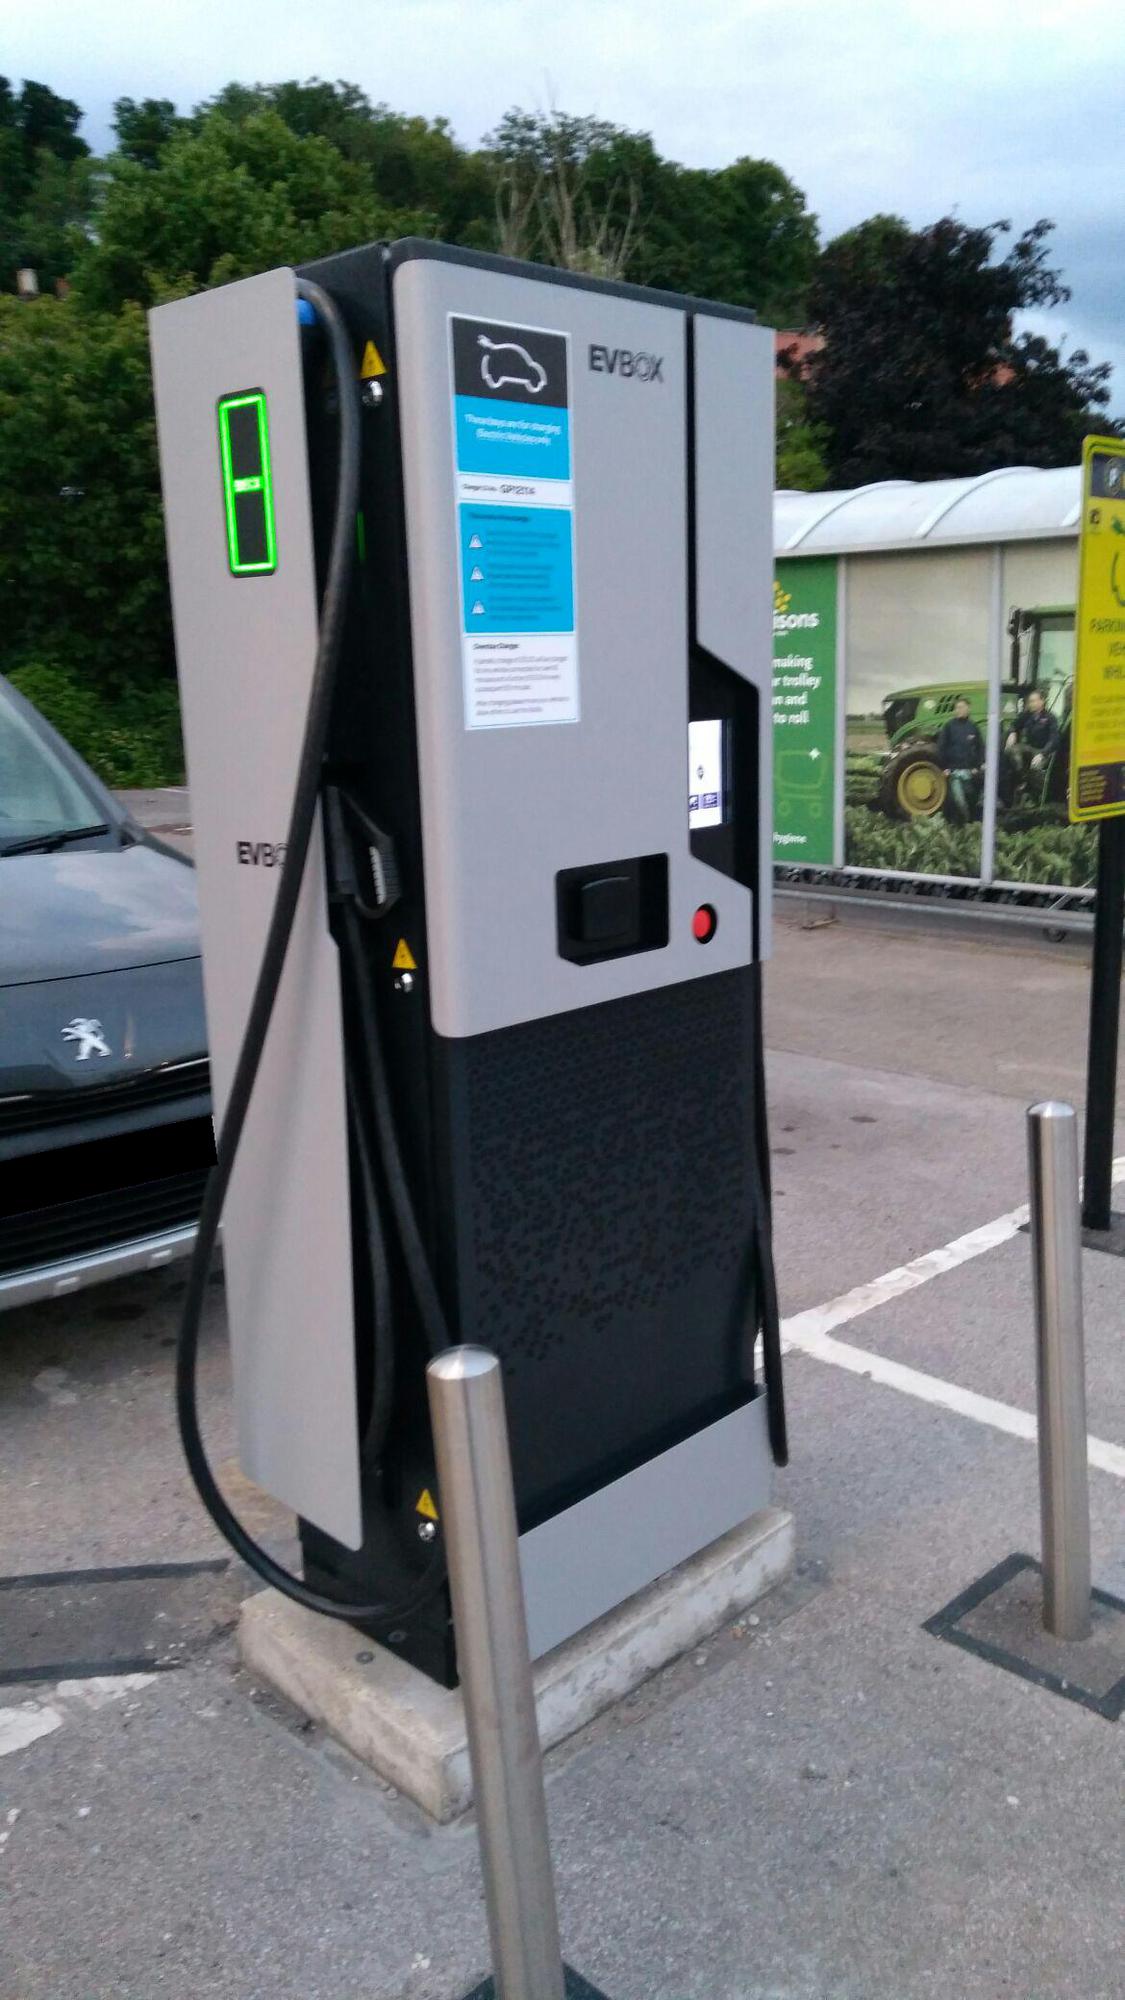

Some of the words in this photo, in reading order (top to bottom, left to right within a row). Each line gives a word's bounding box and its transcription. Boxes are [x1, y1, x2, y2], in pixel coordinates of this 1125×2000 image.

[589, 345, 664, 383] EVBOX
[773, 610, 819, 629] isons
[782, 672, 822, 690] trolley
[784, 691, 808, 705] and
[773, 712, 787, 724] to
[788, 710, 810, 724] roll
[237, 842, 288, 868] EVBO
